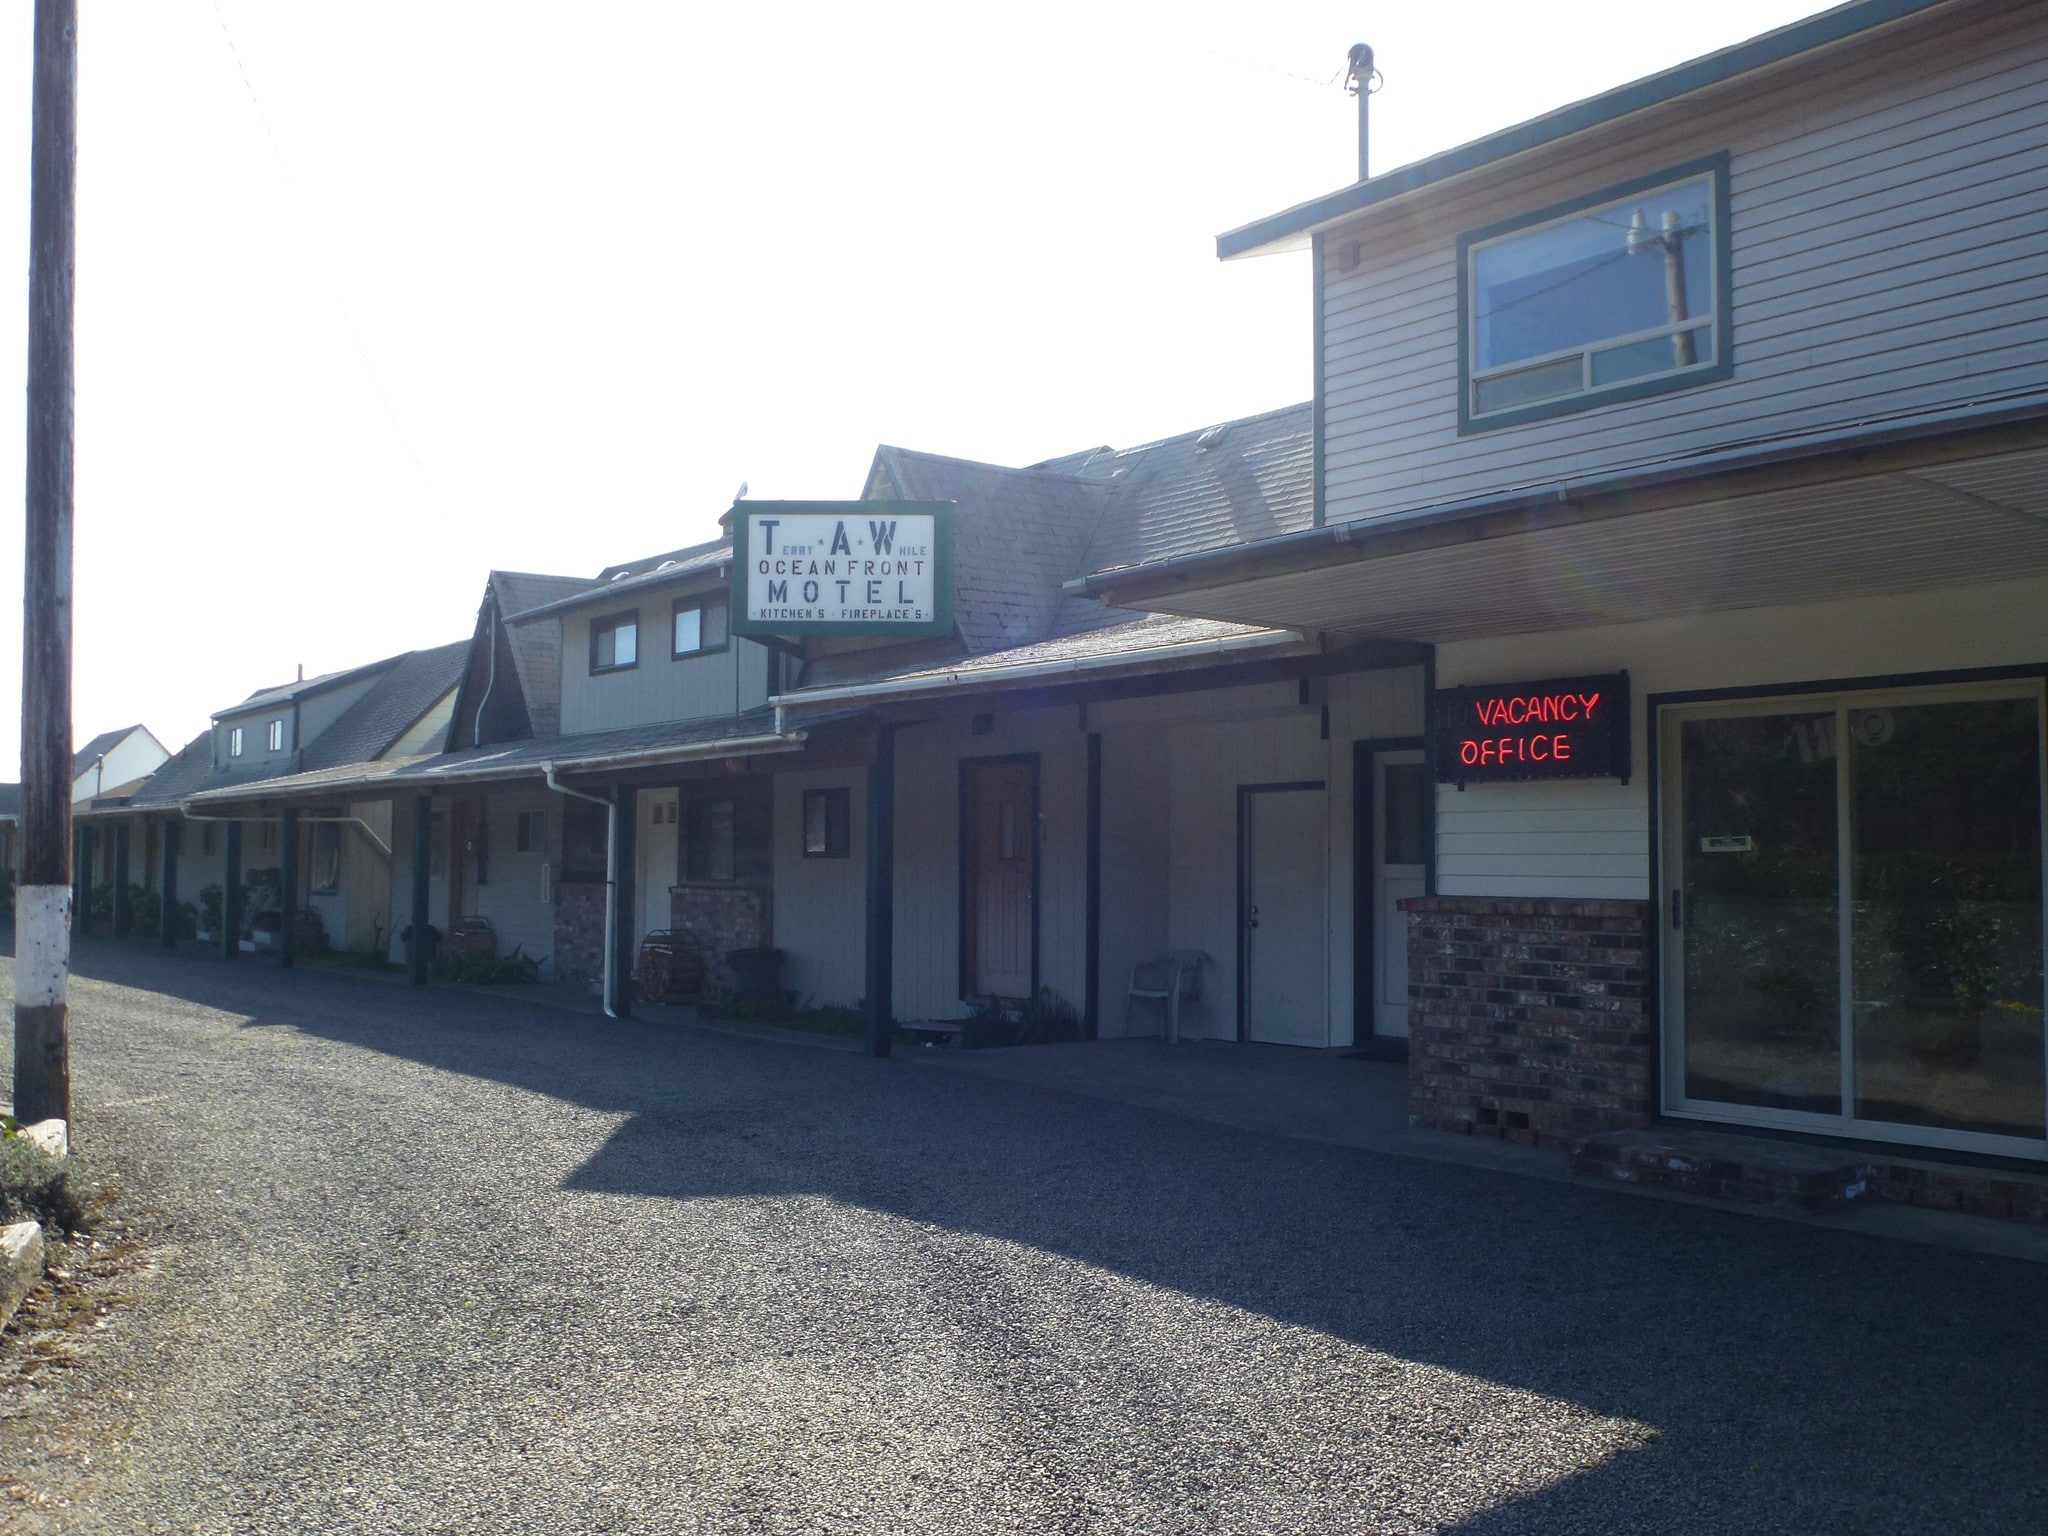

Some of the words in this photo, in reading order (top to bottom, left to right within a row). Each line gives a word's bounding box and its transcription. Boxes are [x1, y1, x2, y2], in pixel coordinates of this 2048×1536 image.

[830, 520, 851, 556] A
[768, 579, 914, 604] MOTEL
[1476, 692, 1600, 725] VACANCY
[1460, 734, 1570, 765] OFFICE
